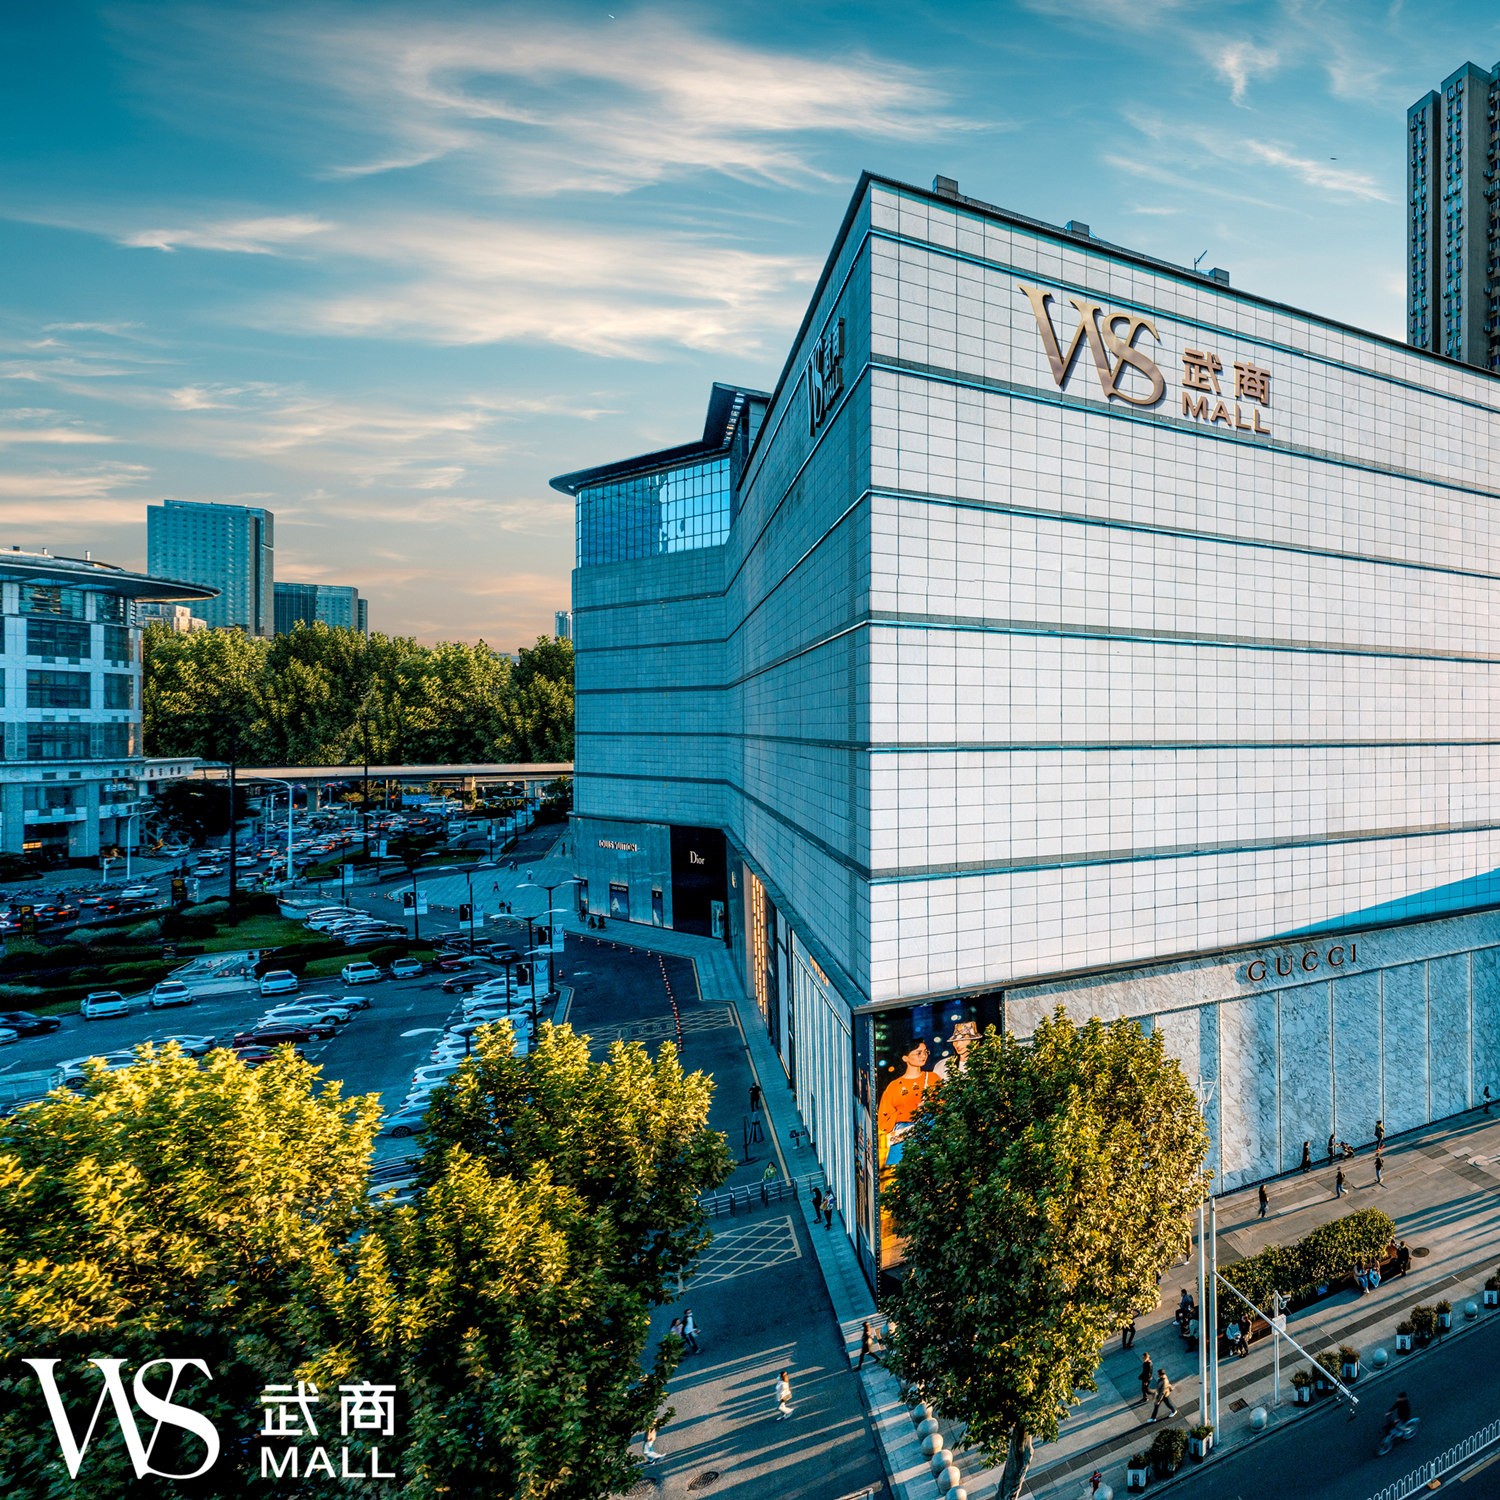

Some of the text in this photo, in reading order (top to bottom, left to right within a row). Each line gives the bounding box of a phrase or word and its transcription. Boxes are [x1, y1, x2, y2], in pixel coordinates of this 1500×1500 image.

[1017, 284, 1167, 406] WS
[1181, 347, 1272, 406] 武商
[1181, 391, 1272, 434] MALL
[689, 850, 705, 865] Dior
[1246, 944, 1357, 982] GUCCI
